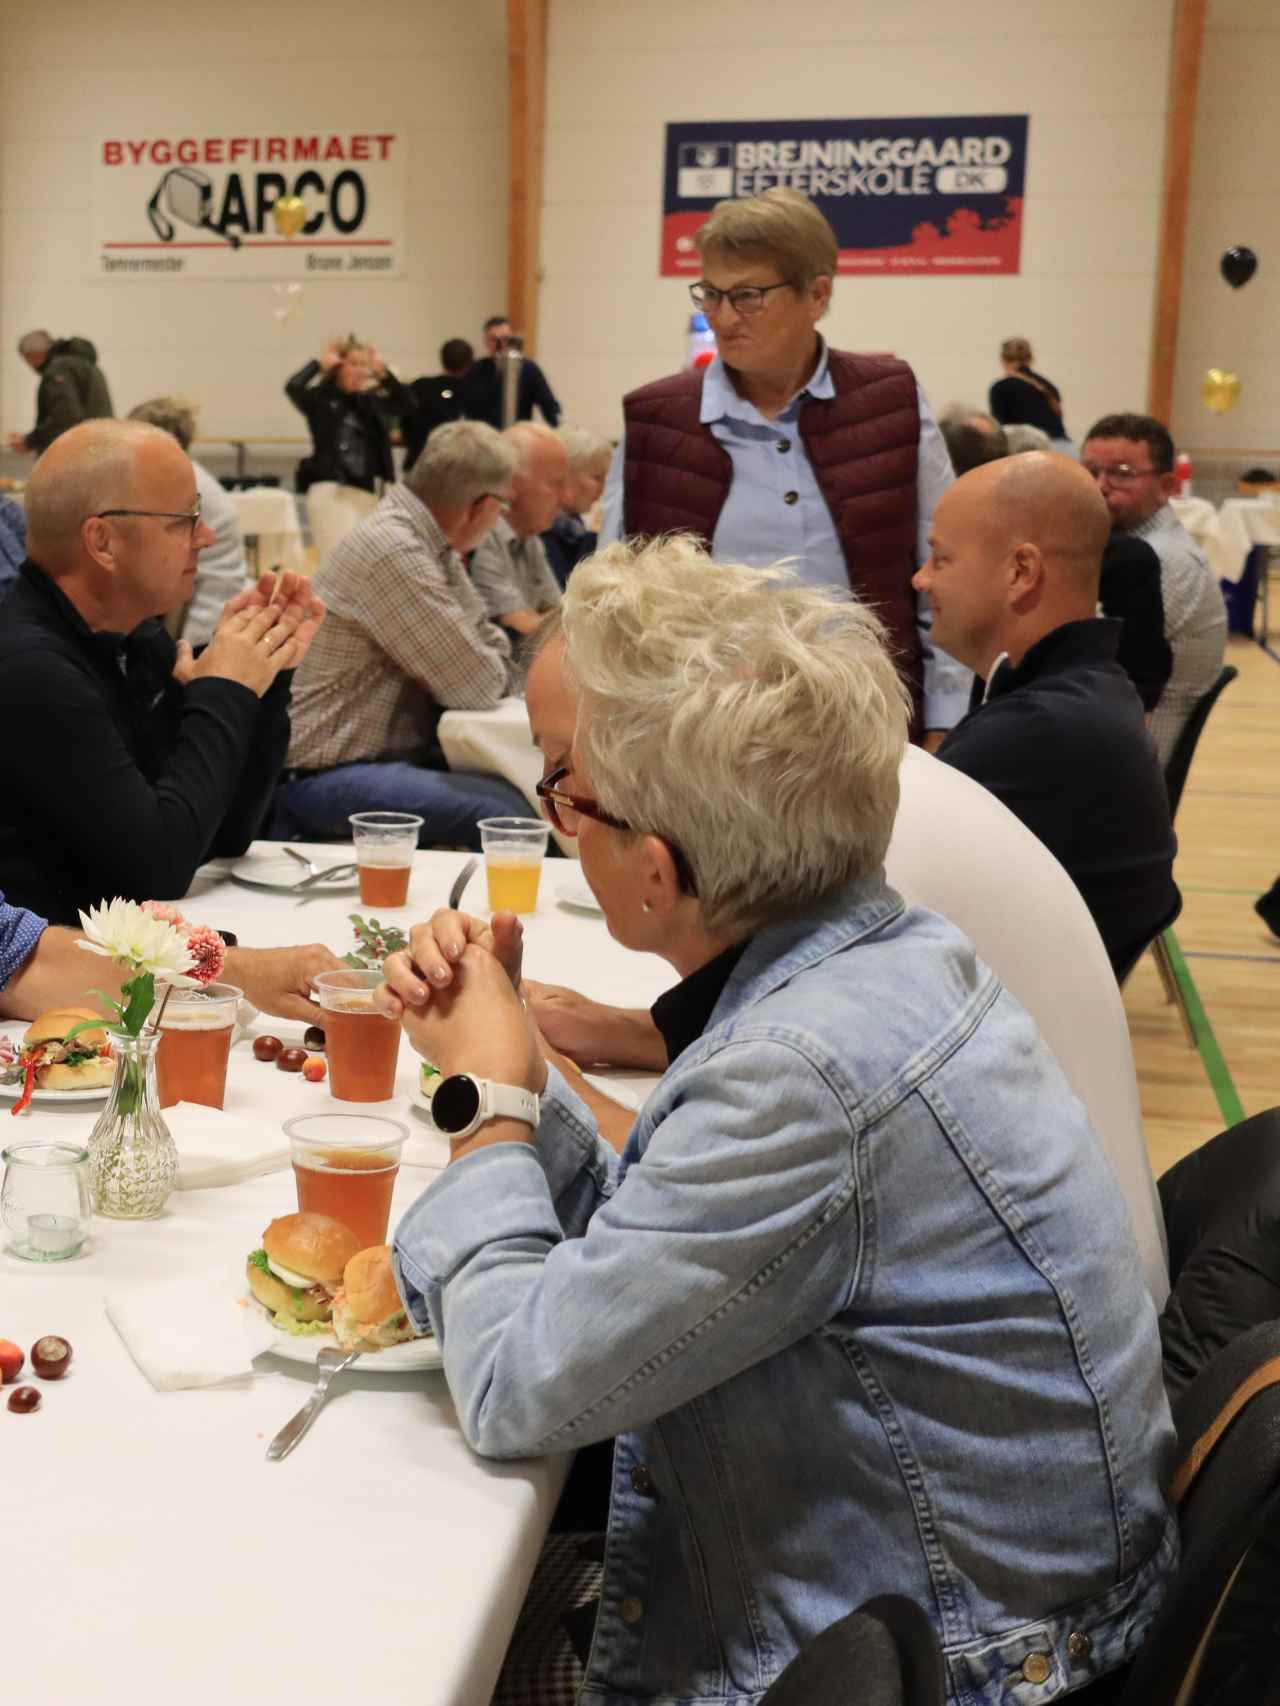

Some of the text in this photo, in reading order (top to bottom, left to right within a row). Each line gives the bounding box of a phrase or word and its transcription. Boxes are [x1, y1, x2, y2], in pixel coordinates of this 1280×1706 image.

[102, 135, 396, 166] BYGGEFIRMAET
[735, 137, 1011, 169] BREJNINGGAARD
[736, 168, 984, 196] EFTERSKOLE DK
